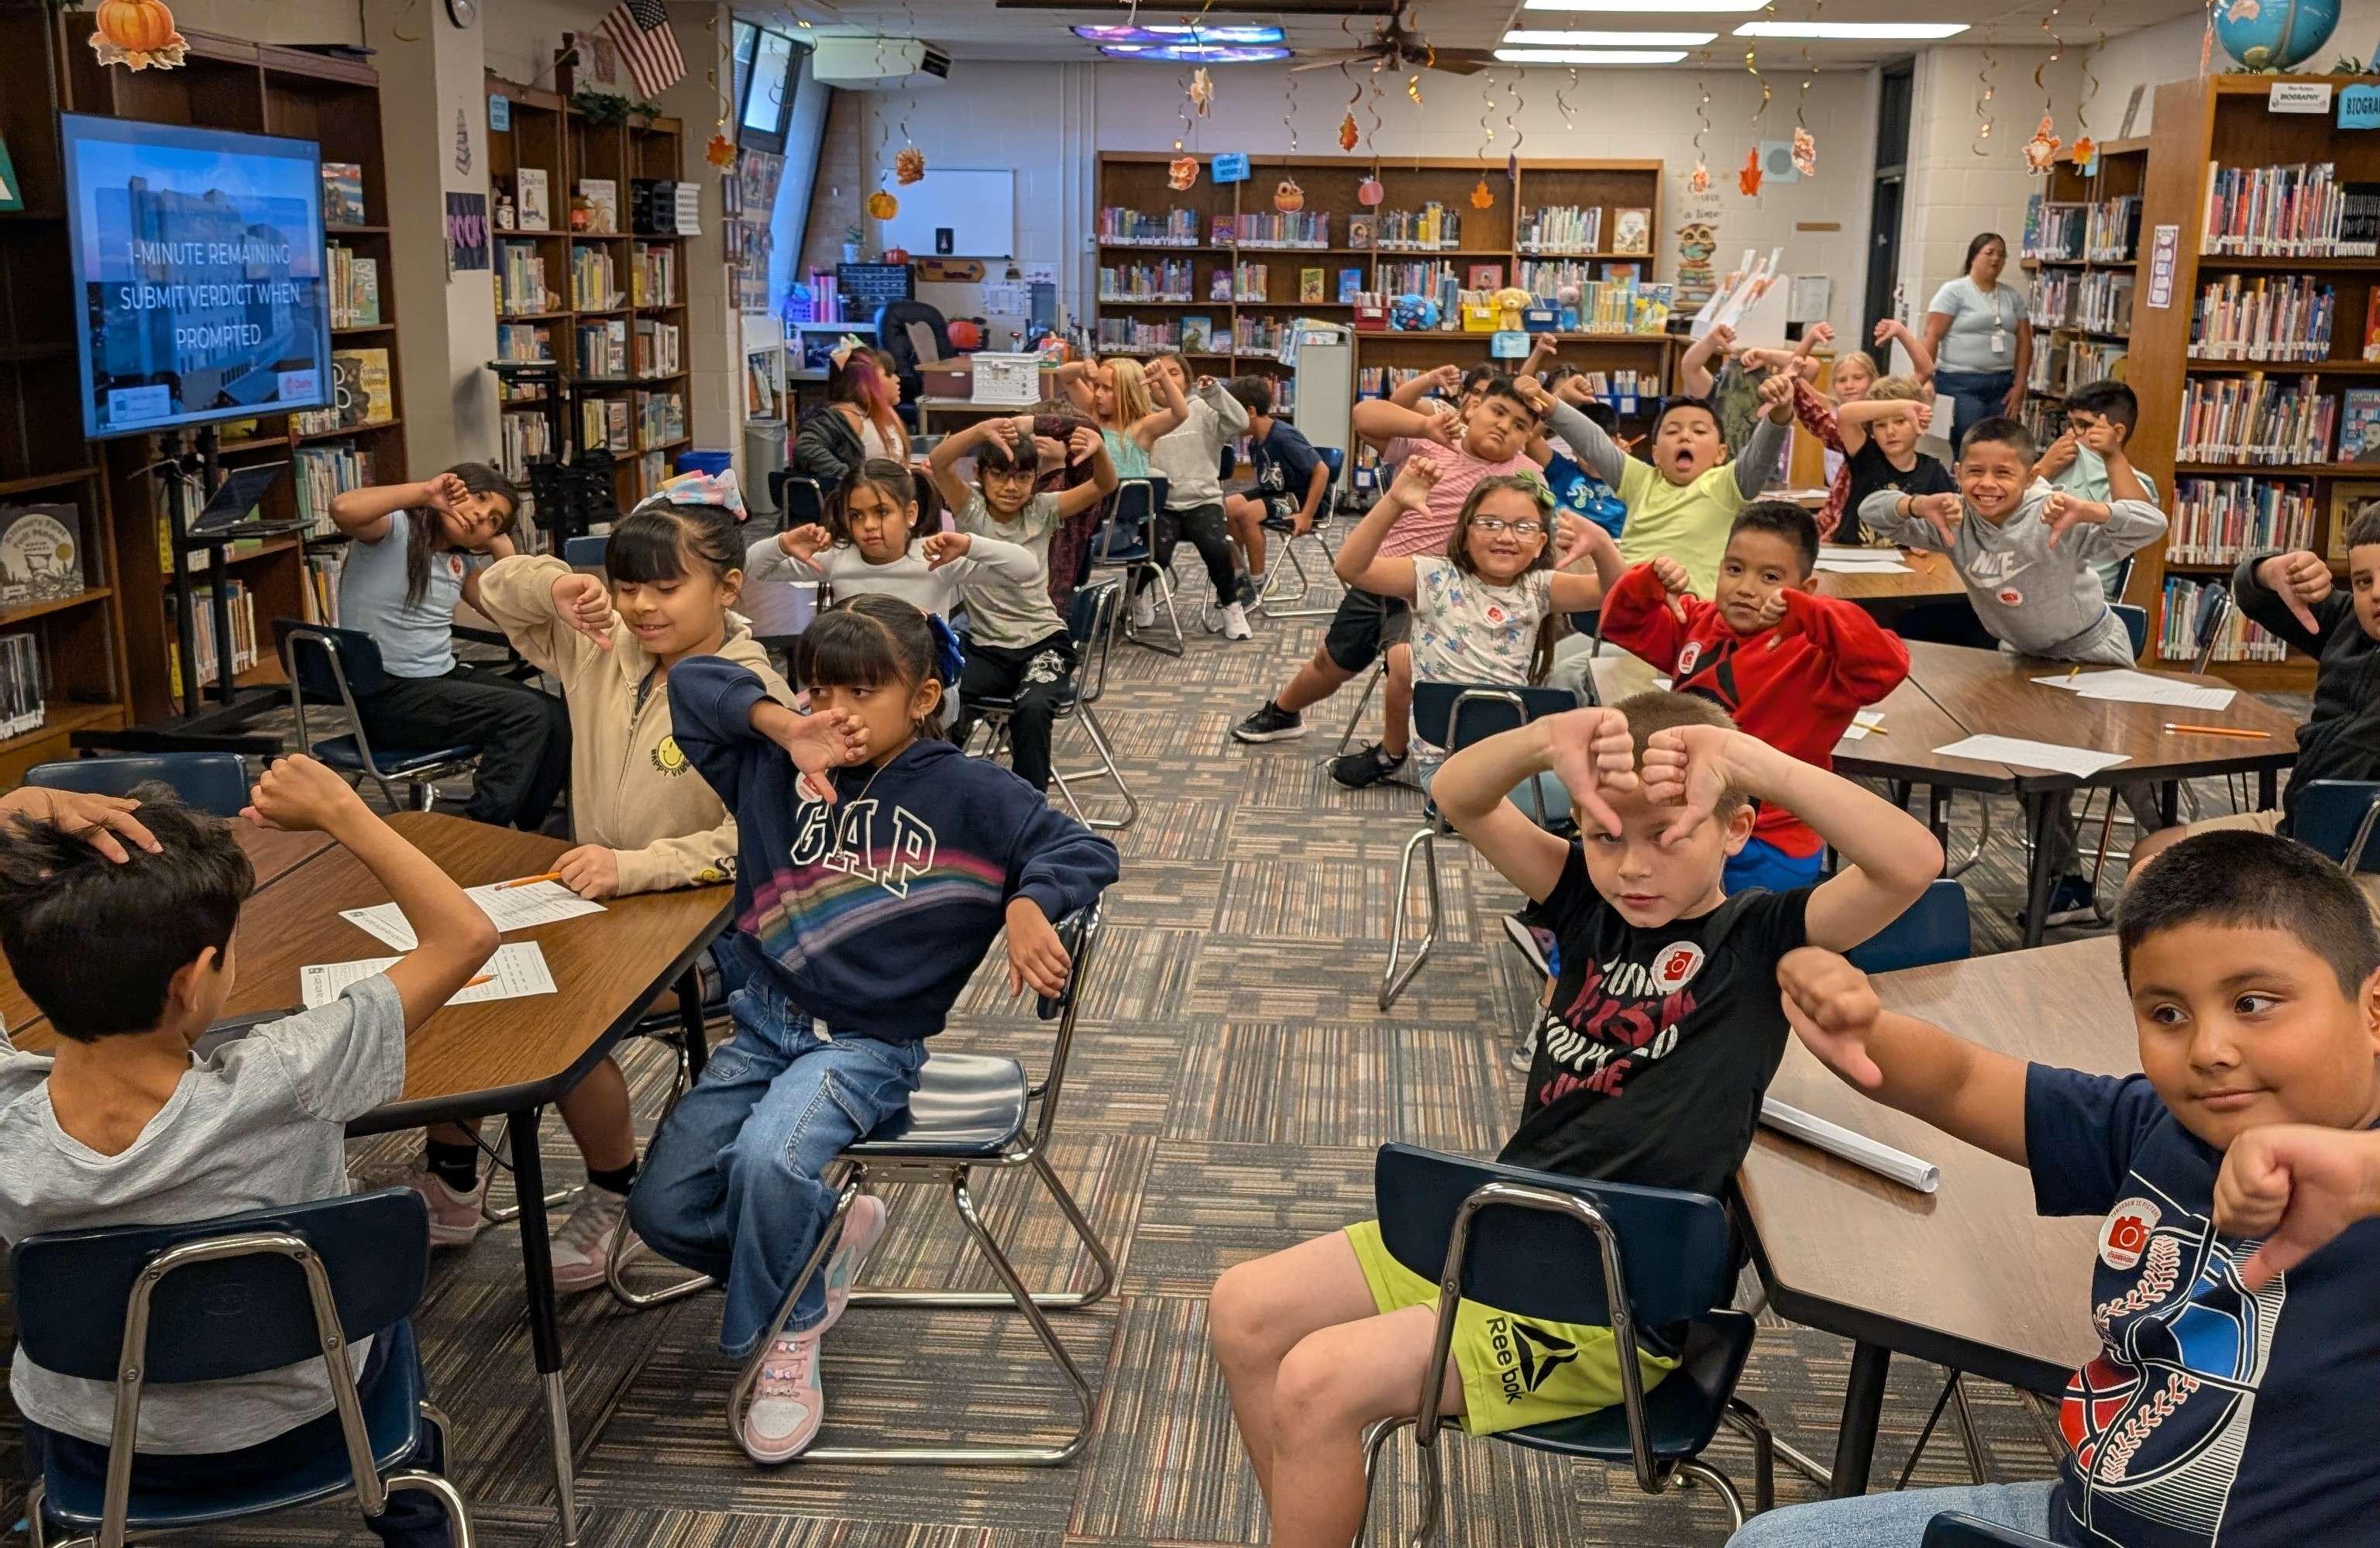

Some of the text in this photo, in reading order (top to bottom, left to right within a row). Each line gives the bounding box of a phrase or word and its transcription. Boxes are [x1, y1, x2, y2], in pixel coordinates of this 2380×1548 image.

[2280, 93, 2320, 101] BIOGRAPHY
[2346, 97, 2380, 115] BIOGRA
[127, 242, 291, 265] 1-MINUTE REMAINING
[120, 282, 301, 310] SUBMIT VERDICT WHEN
[176, 324, 262, 351] PROMPTED
[1971, 550, 2015, 578] NIKE
[651, 748, 669, 777] HAPPY
[790, 798, 937, 900] GAP
[2110, 1199, 2135, 1218] TOMORROW
[1486, 1316, 1525, 1405] Reebok
